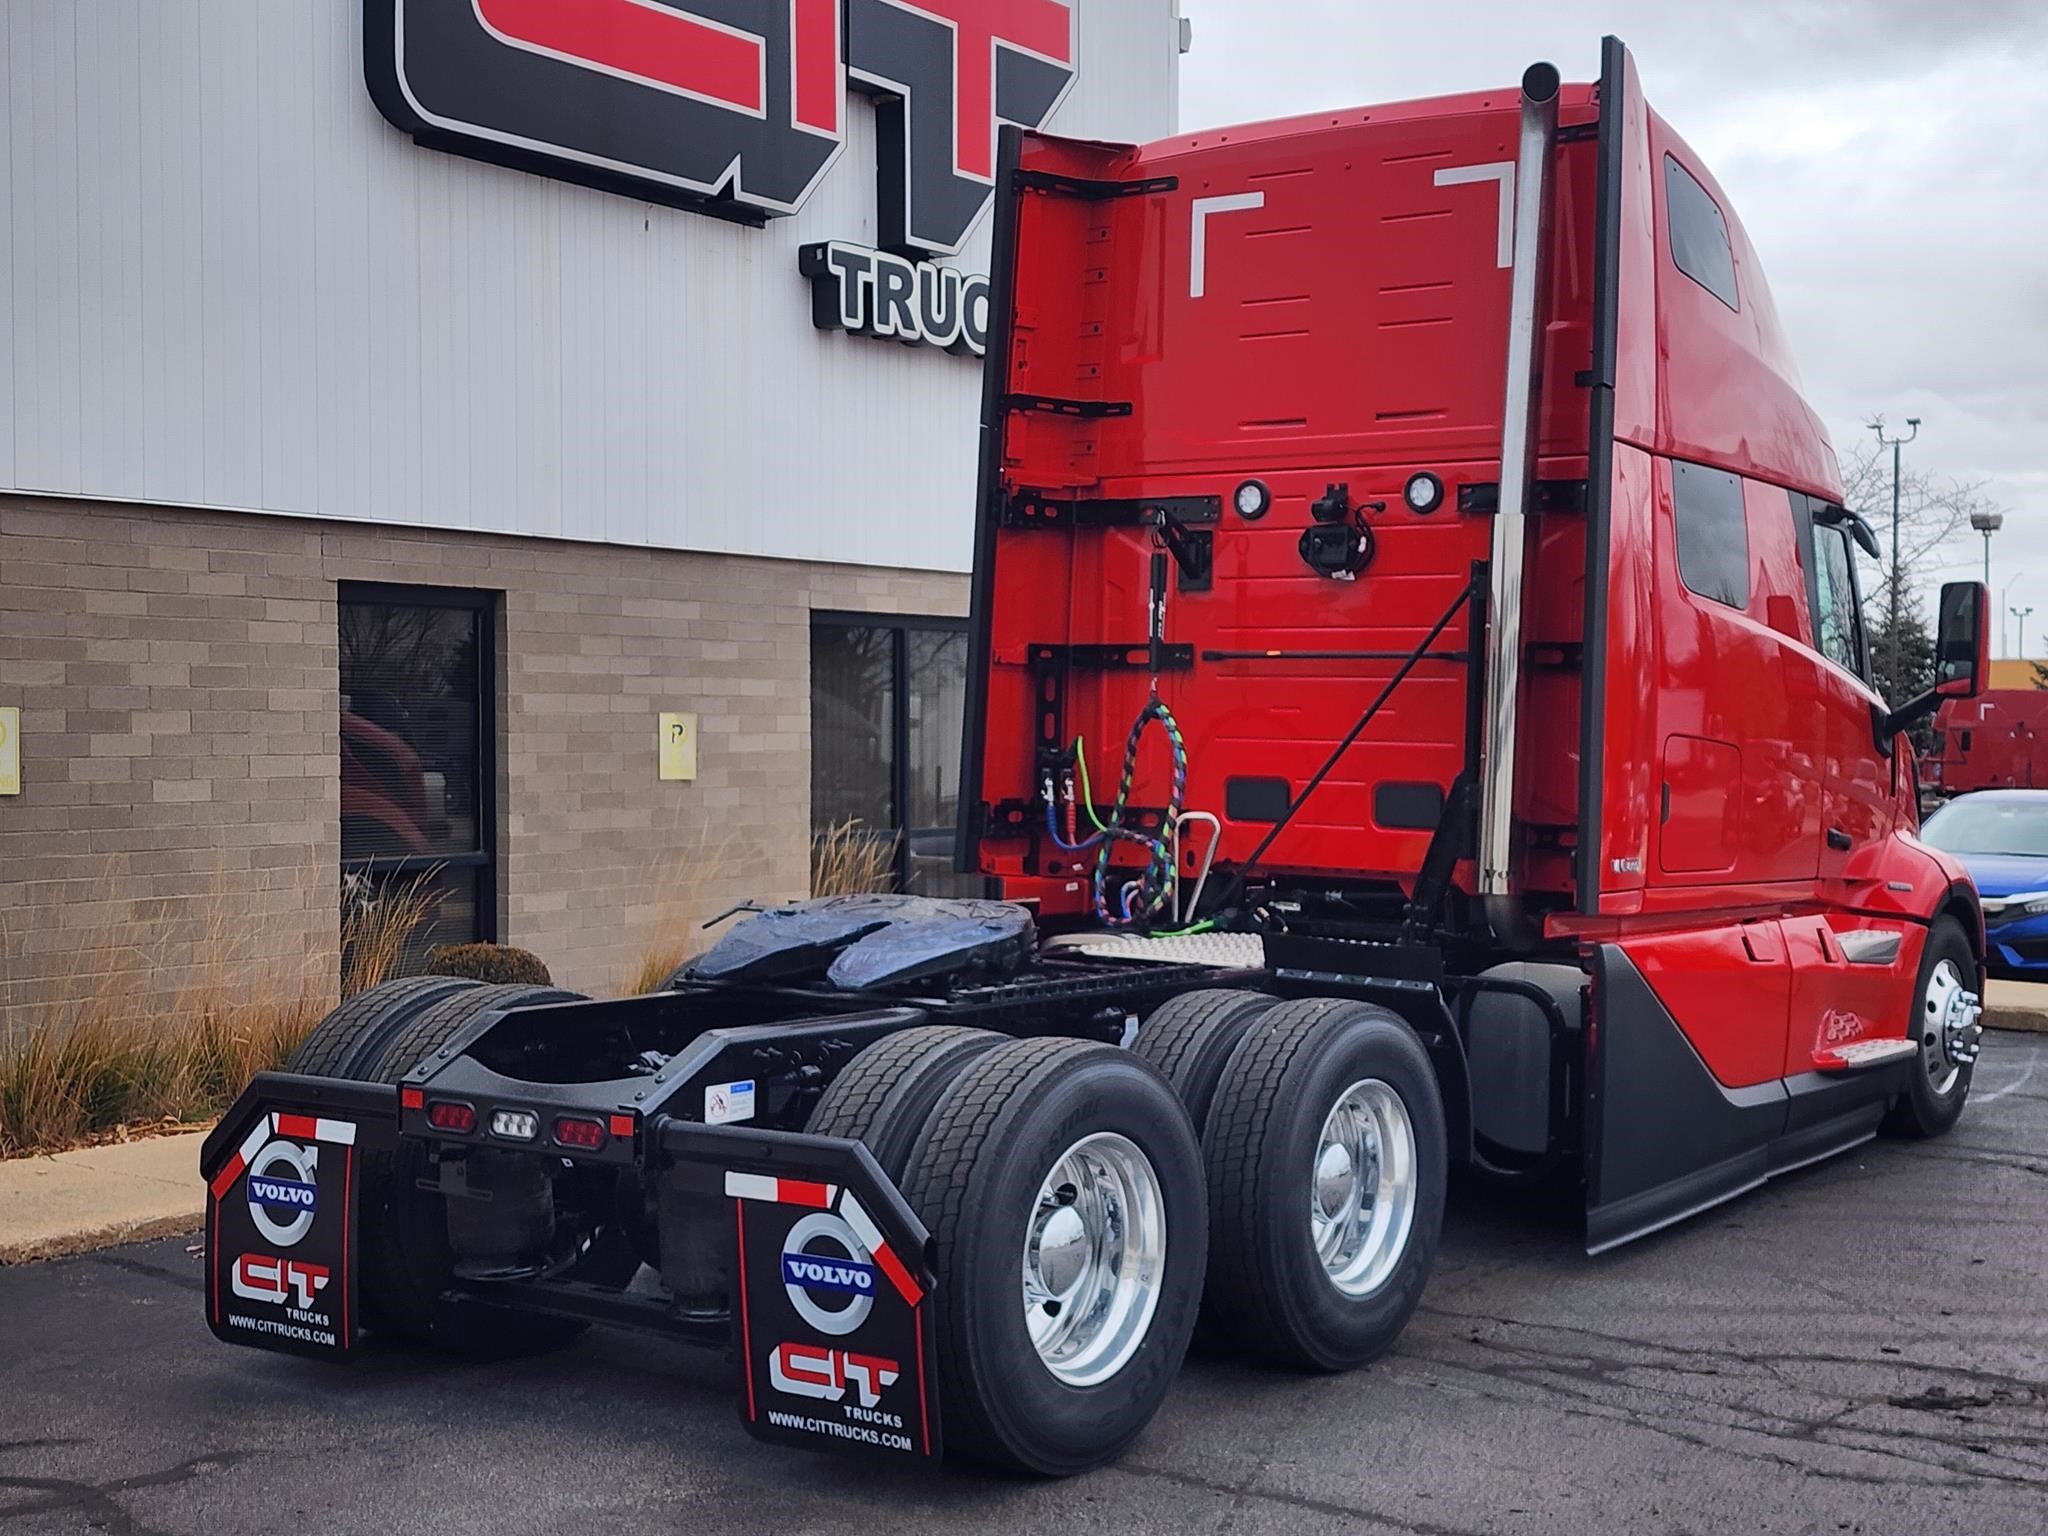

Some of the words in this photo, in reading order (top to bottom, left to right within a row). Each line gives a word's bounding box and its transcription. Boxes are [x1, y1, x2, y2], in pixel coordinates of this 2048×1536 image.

[251, 1182, 314, 1205] VOLVO
[233, 1253, 329, 1309] CIT
[786, 1260, 872, 1289] VOLVO
[229, 1314, 335, 1346] WWW.CITTRUCKS.COM
[286, 1307, 329, 1326] TRUCKS
[770, 1342, 899, 1408] CIT
[768, 1411, 912, 1451] WWW.CITTRUCKS.COM
[843, 1405, 902, 1428] TRUCKS
